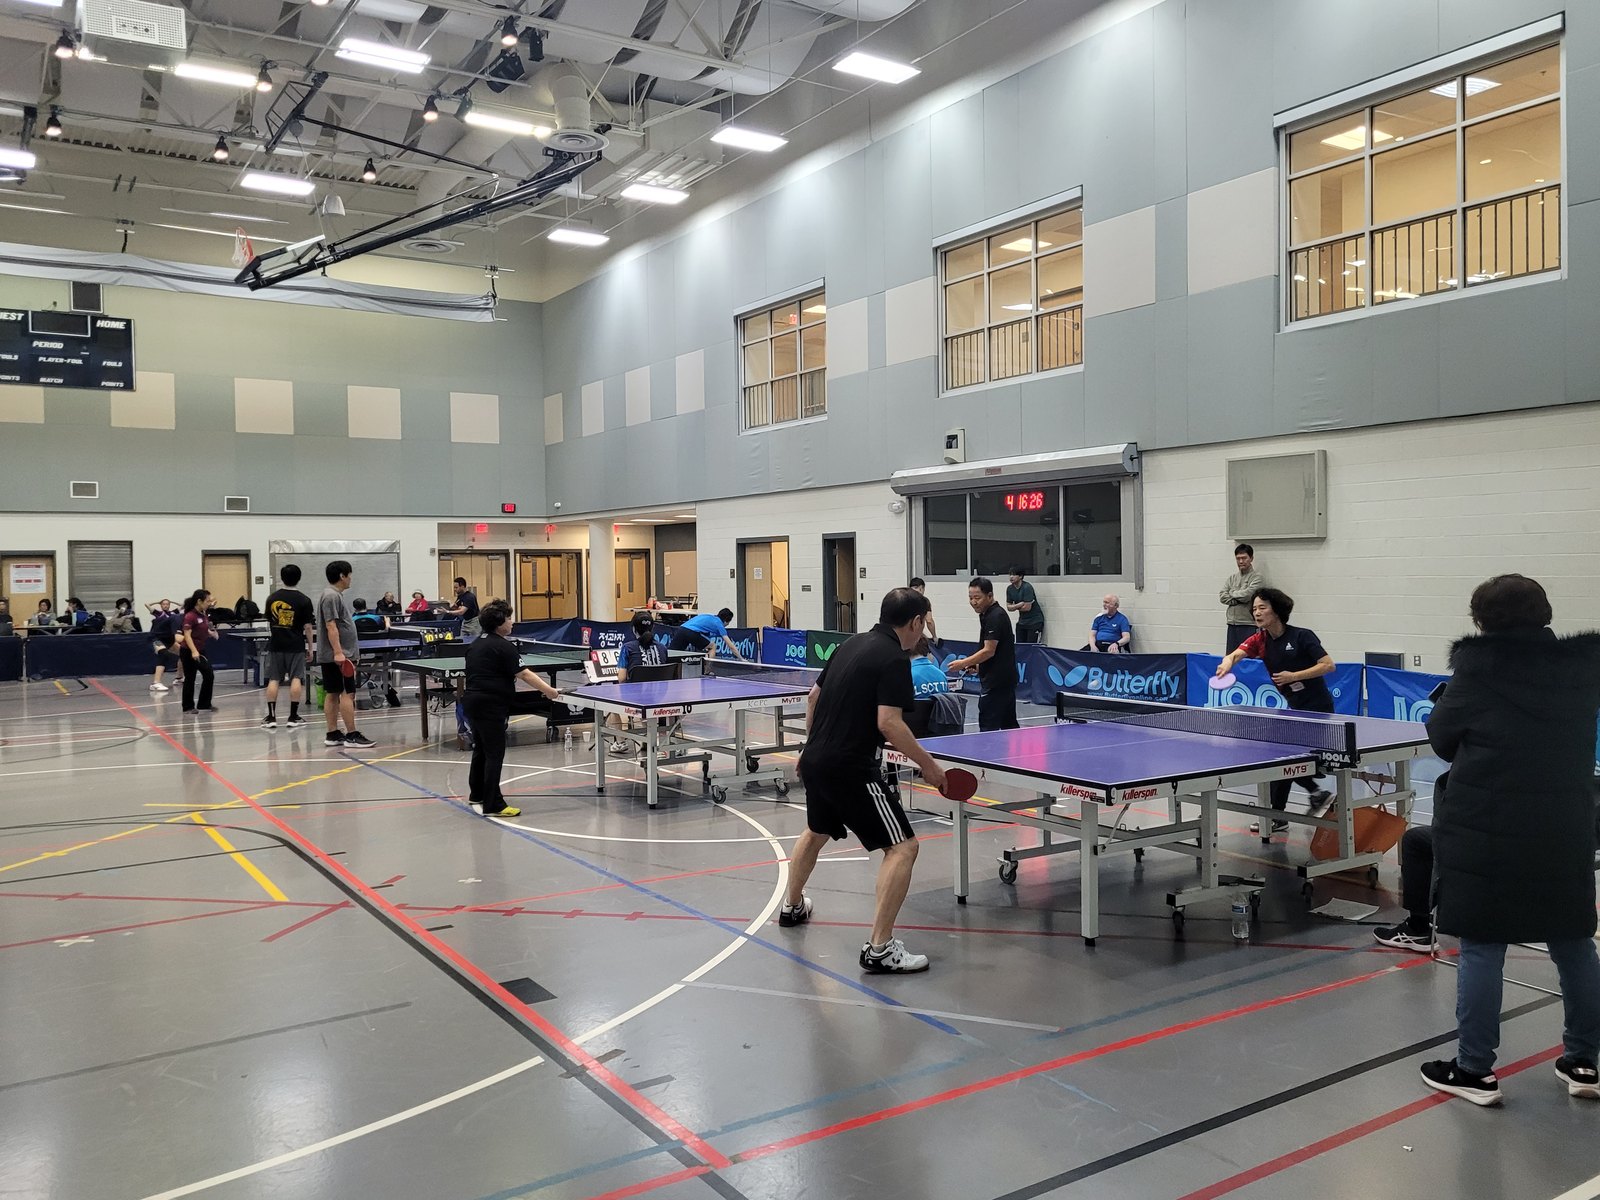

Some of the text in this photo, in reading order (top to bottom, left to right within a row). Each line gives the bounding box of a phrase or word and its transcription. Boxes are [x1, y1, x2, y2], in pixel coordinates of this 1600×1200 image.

[96, 320, 127, 330] HOME
[32, 340, 64, 349] PERIOD
[601, 652, 609, 664] 8
[1087, 666, 1180, 699] Butterfly
[682, 704, 692, 714] 10
[887, 752, 908, 763] MyT9
[1322, 752, 1350, 763] JOOLA
[1283, 765, 1307, 777] MyT9
[1121, 787, 1158, 801] killerspin
